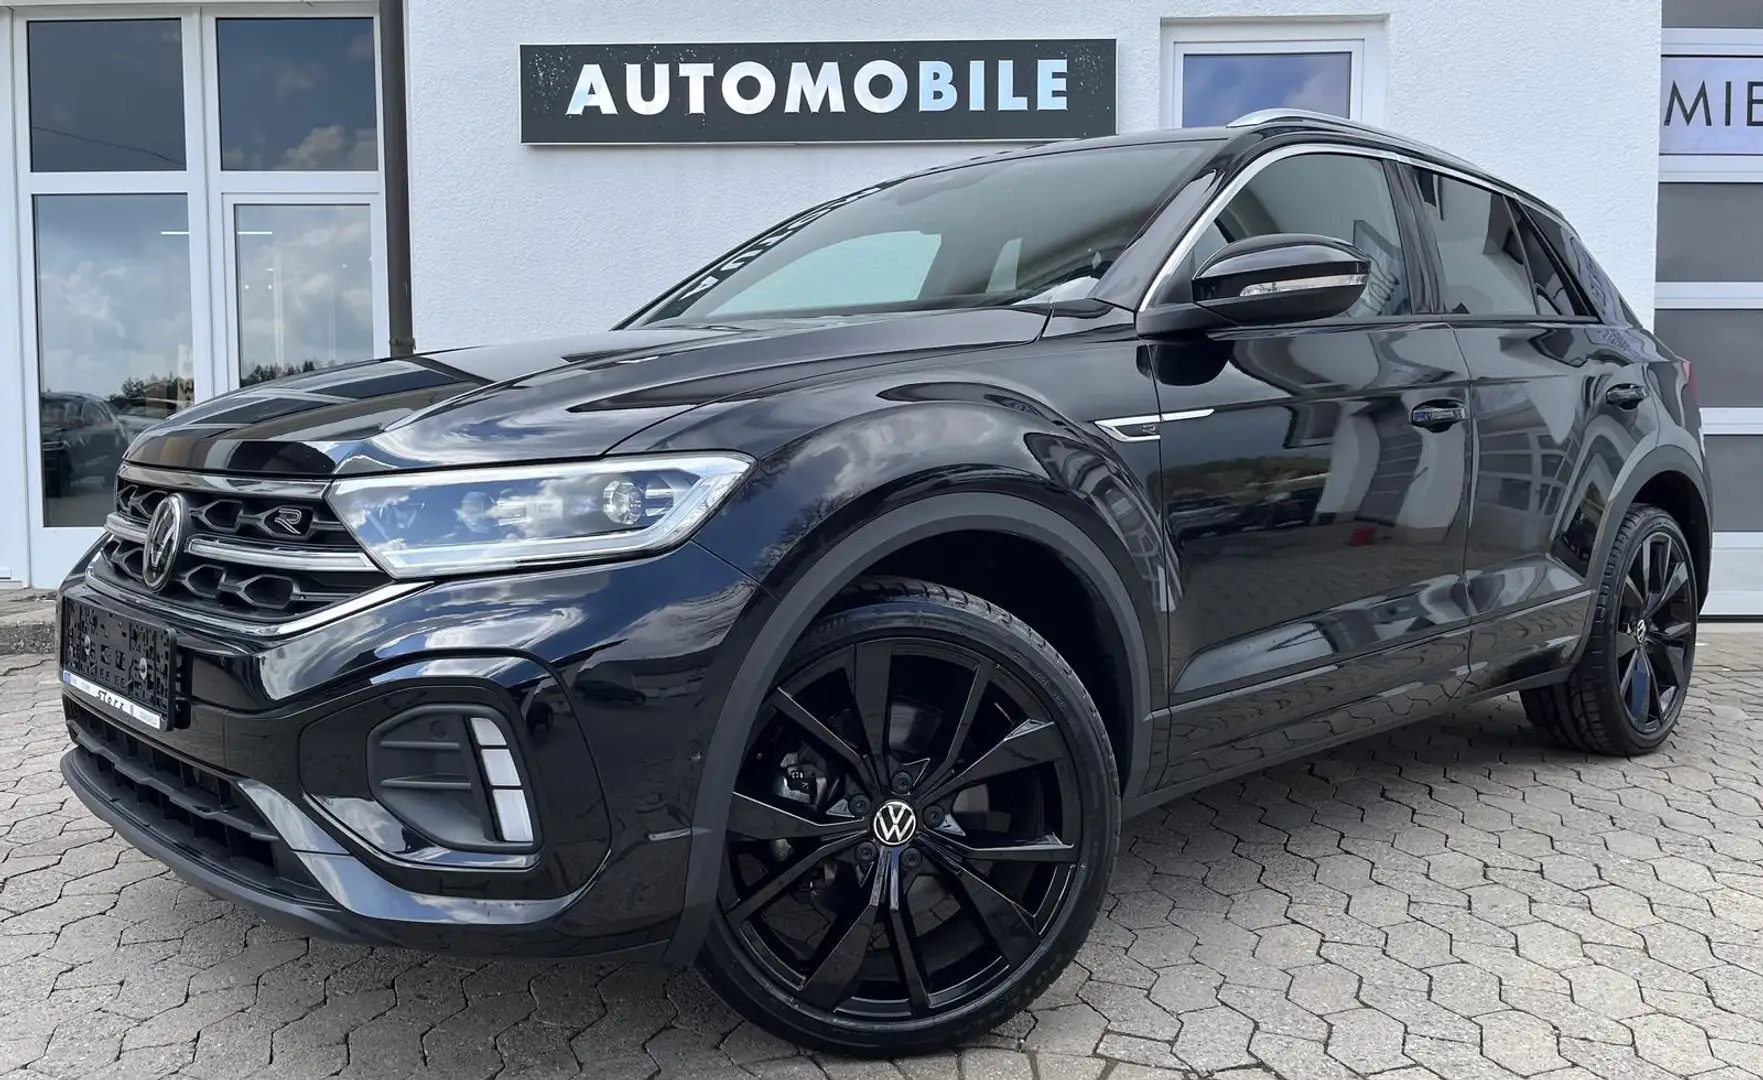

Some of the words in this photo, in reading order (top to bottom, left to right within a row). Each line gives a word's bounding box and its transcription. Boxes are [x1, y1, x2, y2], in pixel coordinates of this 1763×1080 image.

[566, 59, 1068, 115] AUTOMOBILE
[1664, 80, 1763, 126] MIE
[275, 507, 301, 535] R
[874, 801, 916, 845] VW
